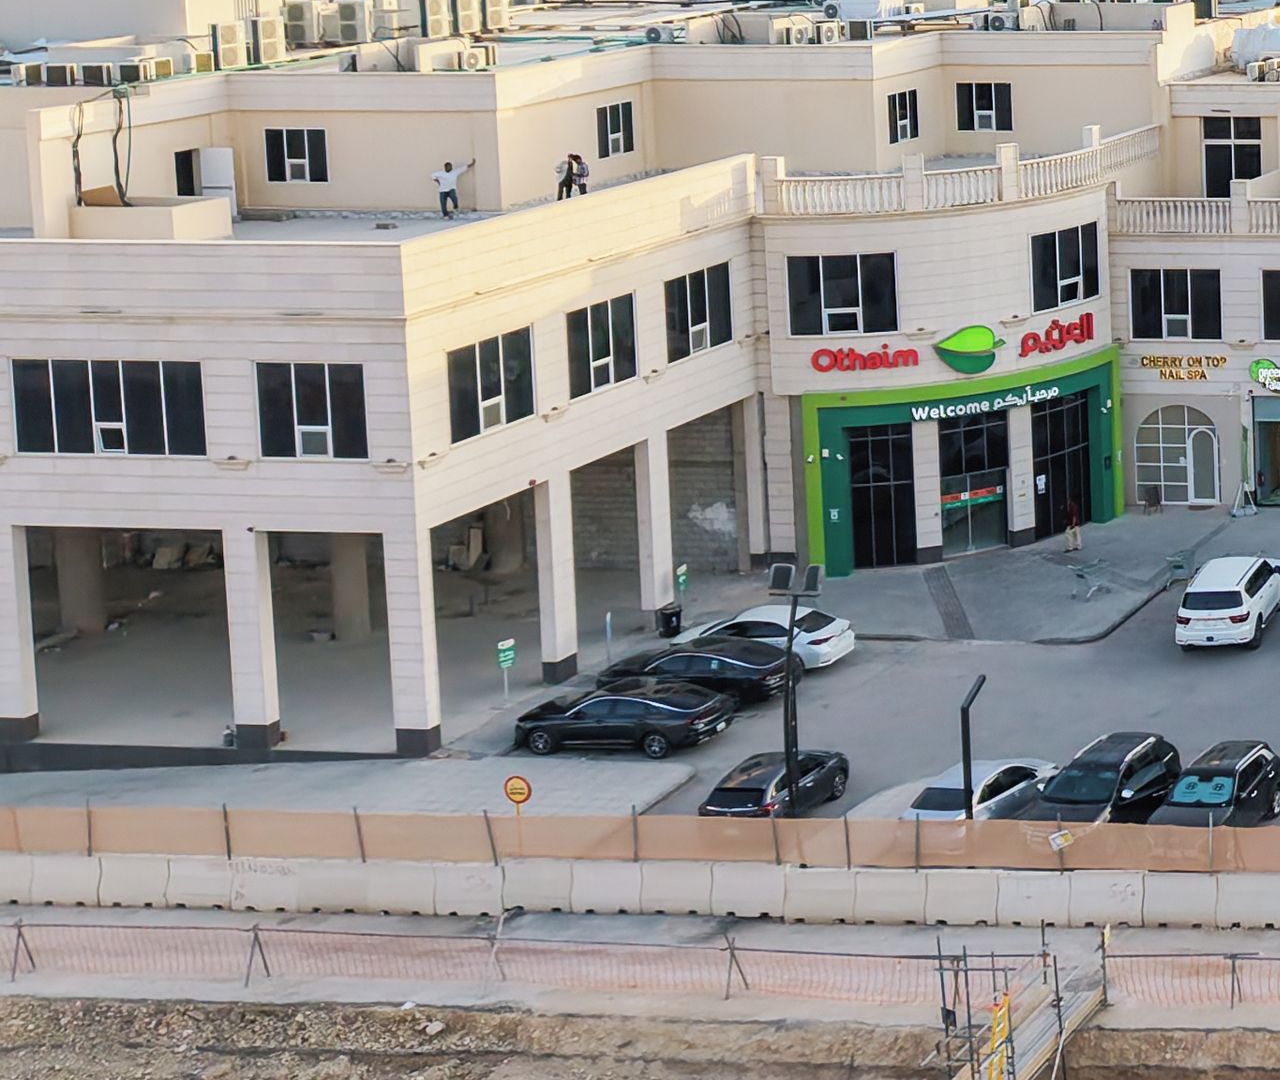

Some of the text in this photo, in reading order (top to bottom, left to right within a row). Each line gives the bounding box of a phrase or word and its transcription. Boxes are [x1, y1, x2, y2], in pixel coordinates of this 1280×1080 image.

[1018, 312, 1094, 358] العثيم
[811, 343, 919, 373] Othaim
[1141, 356, 1227, 368] CHERRY ON TOP
[1160, 369, 1207, 380] NAIL SPA
[911, 400, 990, 422] Welcome
